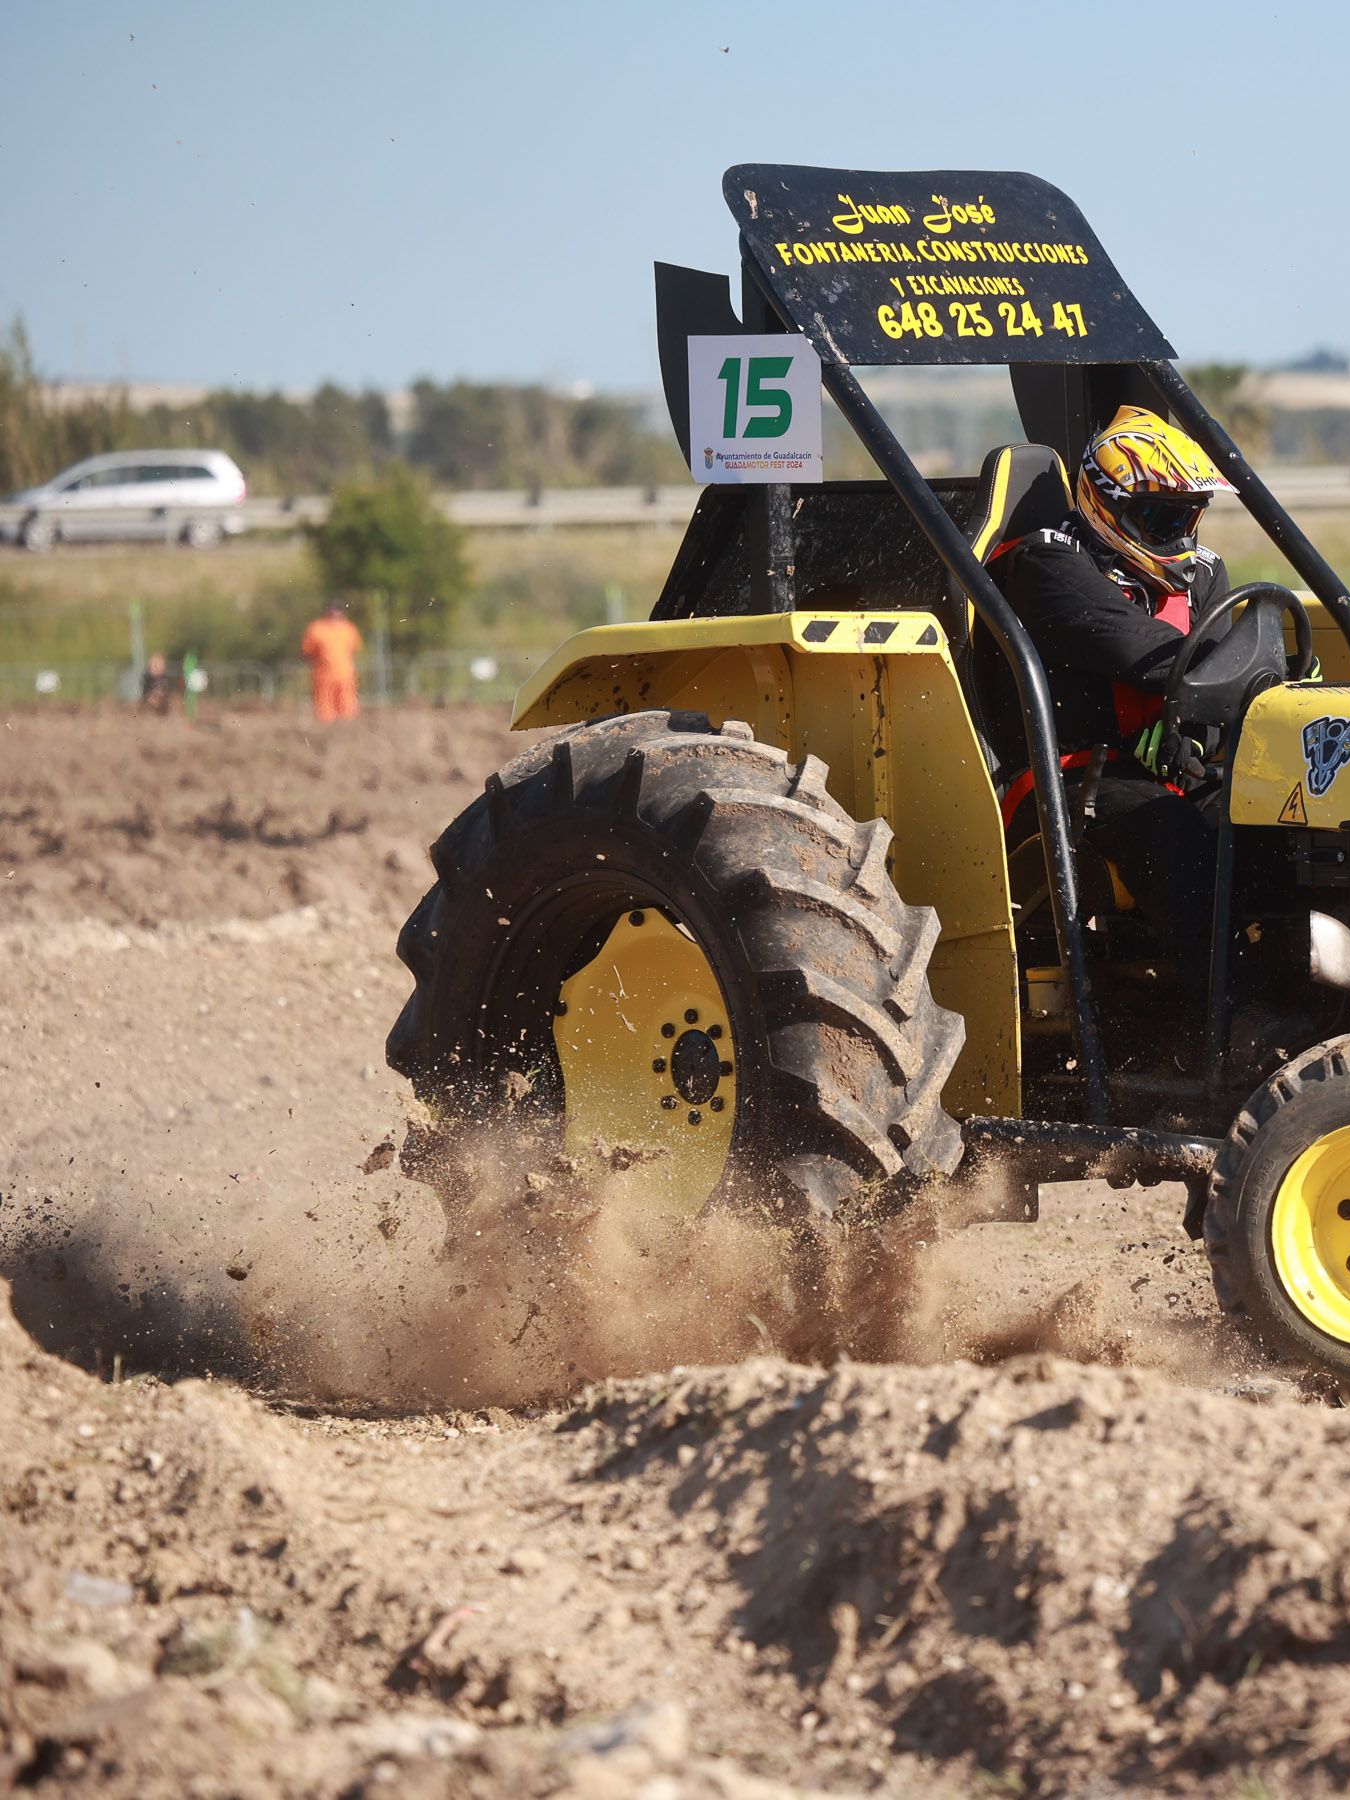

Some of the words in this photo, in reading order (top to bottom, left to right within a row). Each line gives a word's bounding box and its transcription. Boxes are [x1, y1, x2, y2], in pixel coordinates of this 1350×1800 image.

[831, 193, 911, 235] Juan
[922, 193, 996, 234] José
[889, 277, 905, 298] Y
[906, 275, 1025, 296] EXCAVACIONES
[877, 301, 943, 340] 648
[949, 301, 994, 338] 25
[998, 301, 1044, 338] 24
[1052, 302, 1088, 338] 47
[717, 356, 794, 439] 15
[716, 452, 762, 462] Ayuntamiento
[763, 452, 772, 460] de
[773, 451, 812, 460] Guadalcacín
[724, 461, 769, 469] GUADAMOTOR
[770, 461, 785, 469] FEST
[786, 460, 803, 469] 2024
